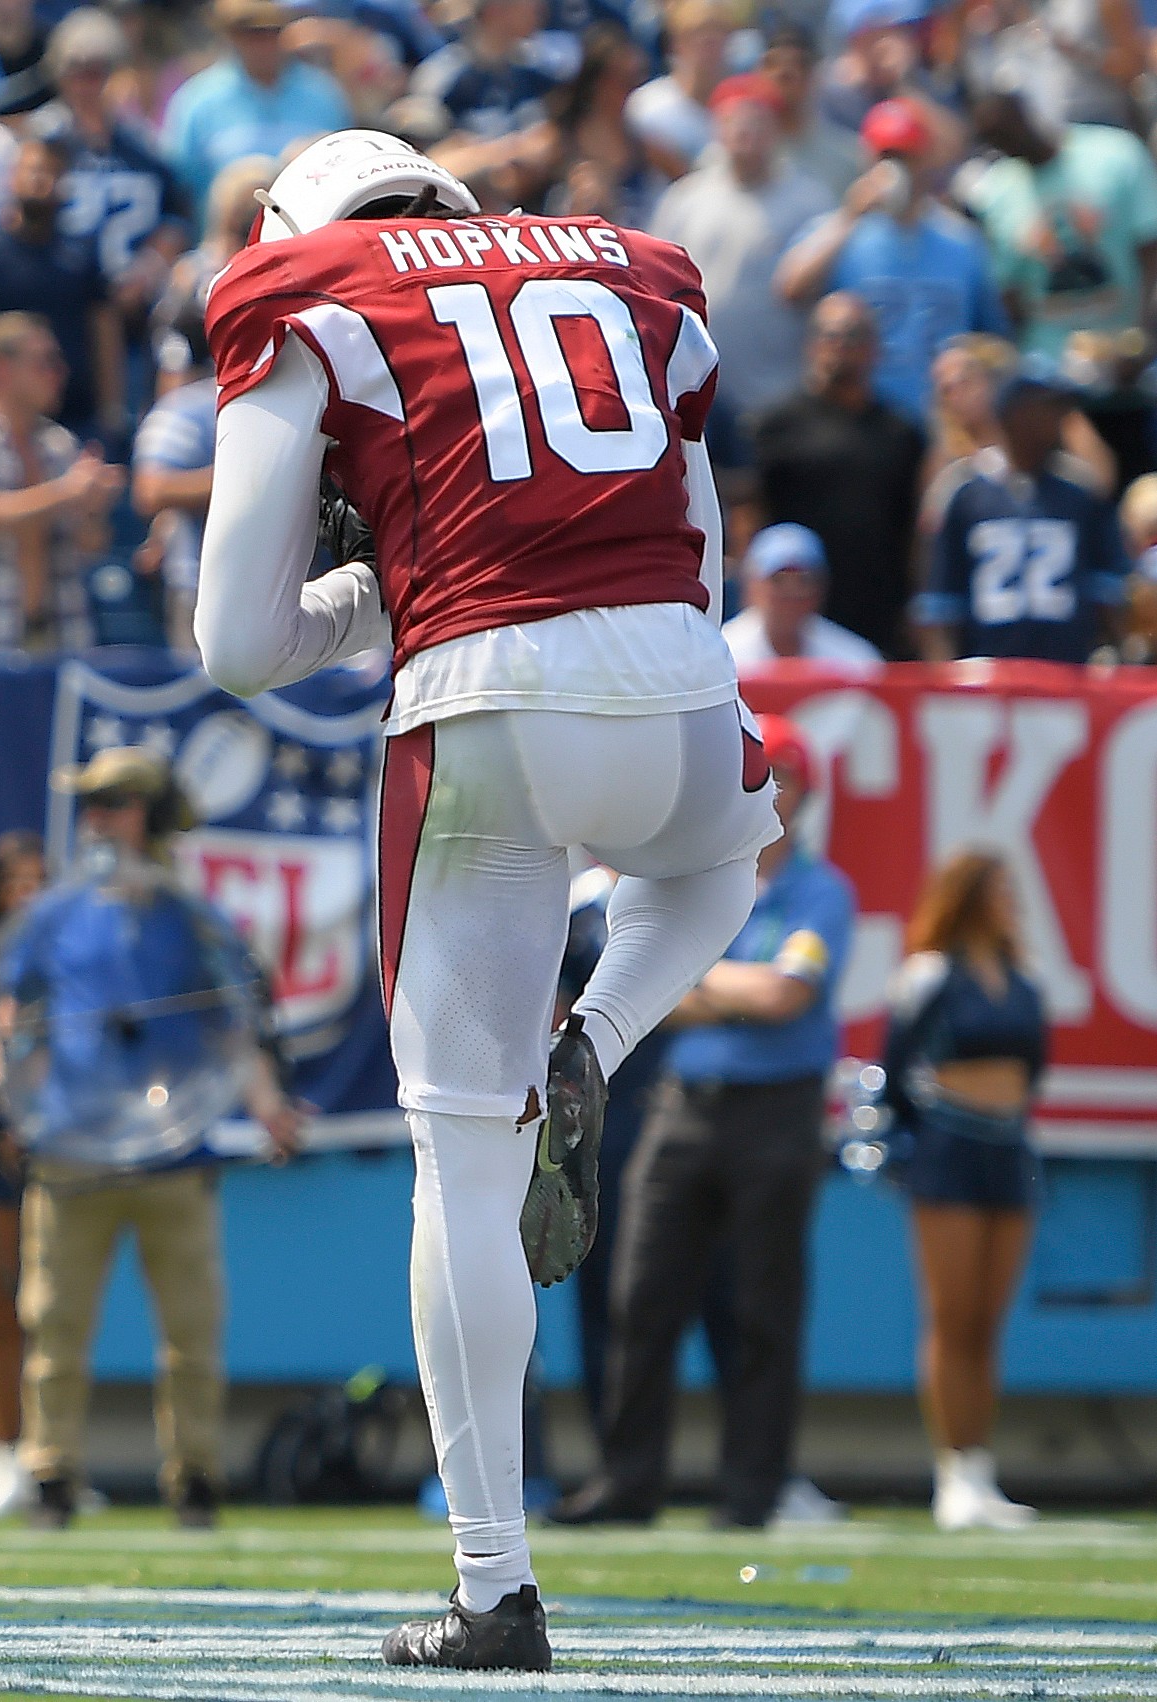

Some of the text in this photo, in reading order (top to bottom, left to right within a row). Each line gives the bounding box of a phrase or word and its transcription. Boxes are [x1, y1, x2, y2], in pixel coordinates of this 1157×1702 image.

[380, 225, 629, 273] HOPKINS
[426, 278, 669, 482] 10
[967, 518, 1077, 622] 22
